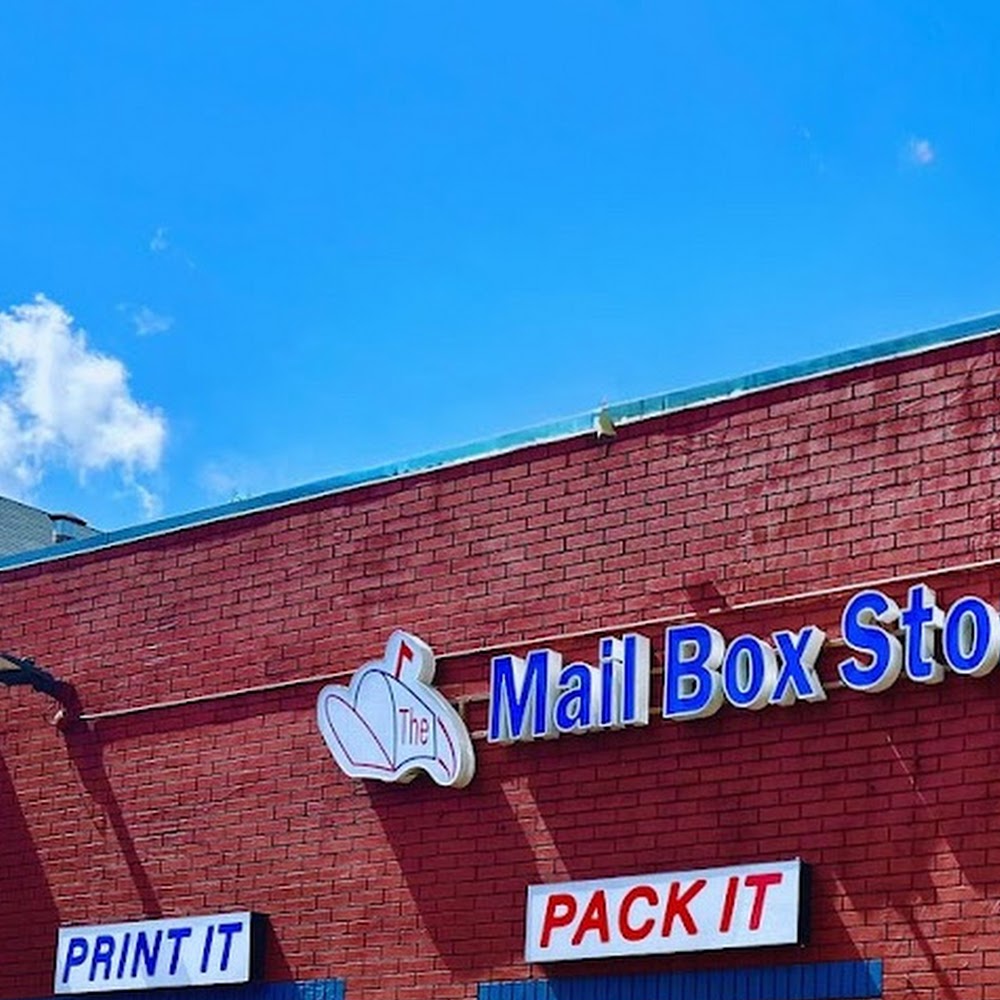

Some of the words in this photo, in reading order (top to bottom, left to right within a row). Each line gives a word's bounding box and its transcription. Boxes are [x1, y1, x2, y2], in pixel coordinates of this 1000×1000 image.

[488, 633, 641, 743] Mail
[662, 622, 820, 718] Box
[399, 707, 430, 745] The
[540, 878, 708, 949] PACK
[719, 873, 783, 934] IT
[62, 927, 192, 984] PRINT
[200, 921, 243, 974] IT
